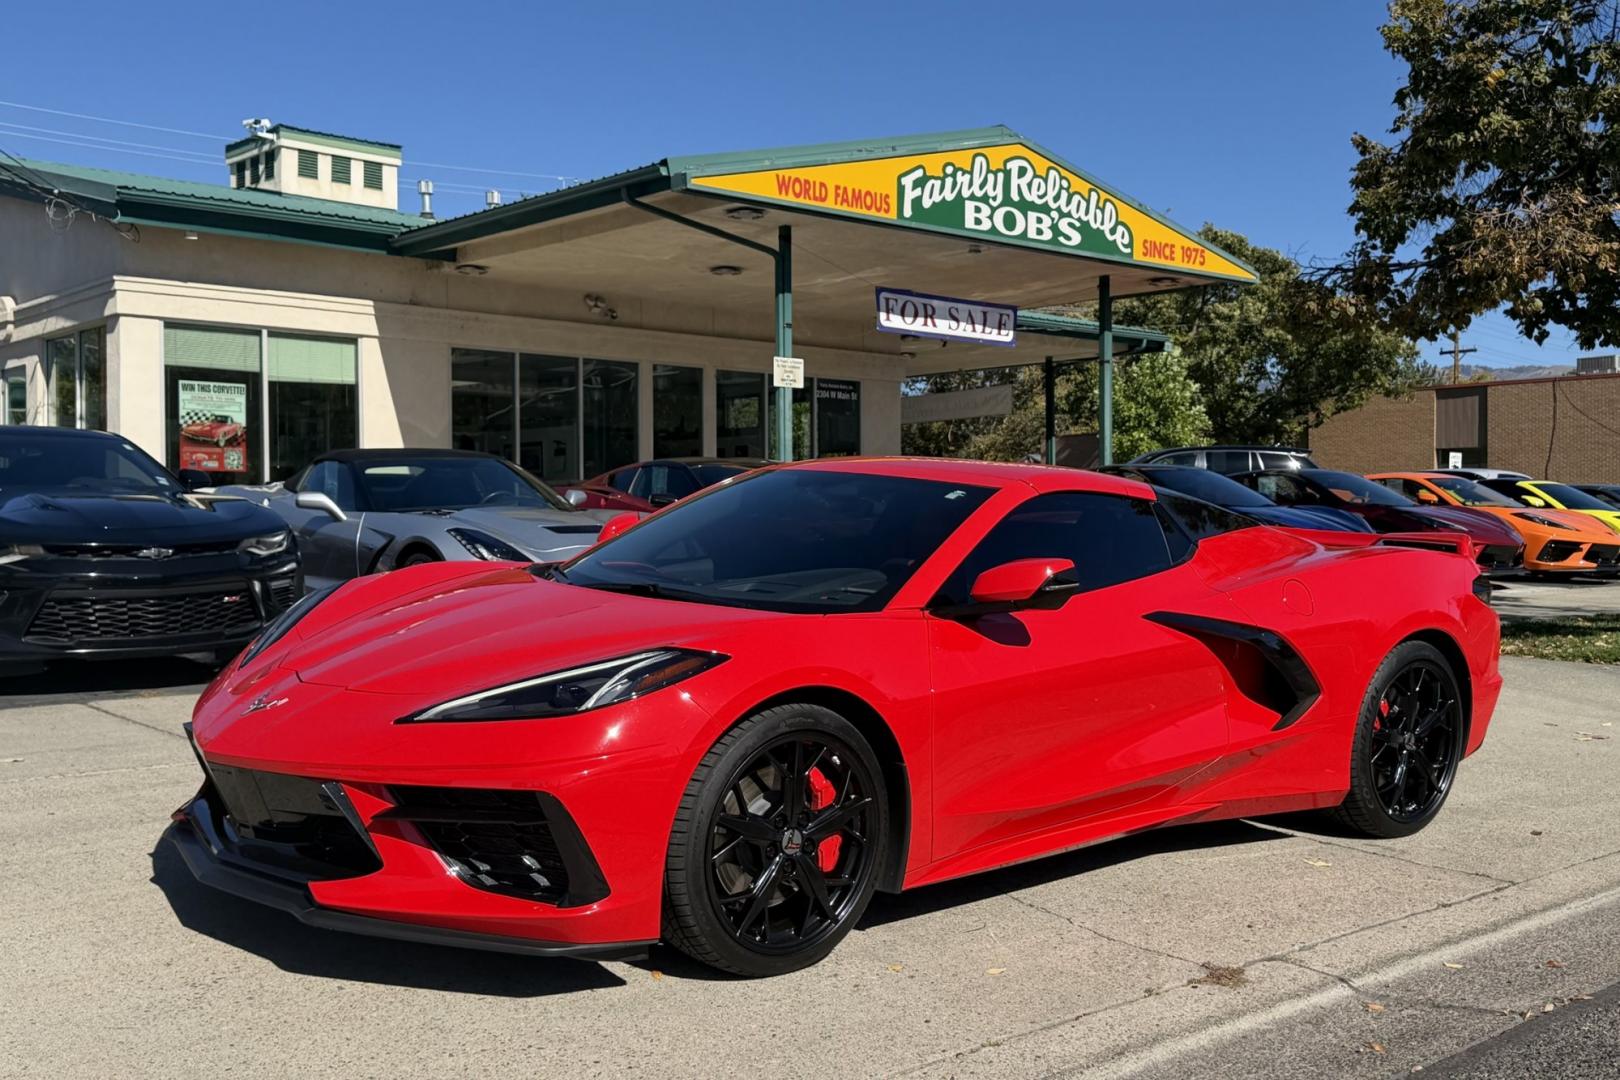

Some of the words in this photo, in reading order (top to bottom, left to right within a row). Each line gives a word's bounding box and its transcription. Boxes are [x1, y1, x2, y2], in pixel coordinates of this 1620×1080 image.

[776, 173, 828, 203] WORLD
[834, 184, 891, 214] FAMOUS
[901, 155, 1004, 218] Fairly
[1006, 158, 1131, 254] Reliable
[964, 200, 1082, 246] BOB'S
[1142, 239, 1176, 262] SINCE
[1180, 246, 1206, 266] 1975
[883, 297, 938, 328] FOR
[948, 306, 1010, 337] SALE
[181, 383, 196, 392] WIN
[197, 384, 212, 393] THIS
[213, 385, 246, 396] CORVETTE!
[837, 391, 851, 400] Main
